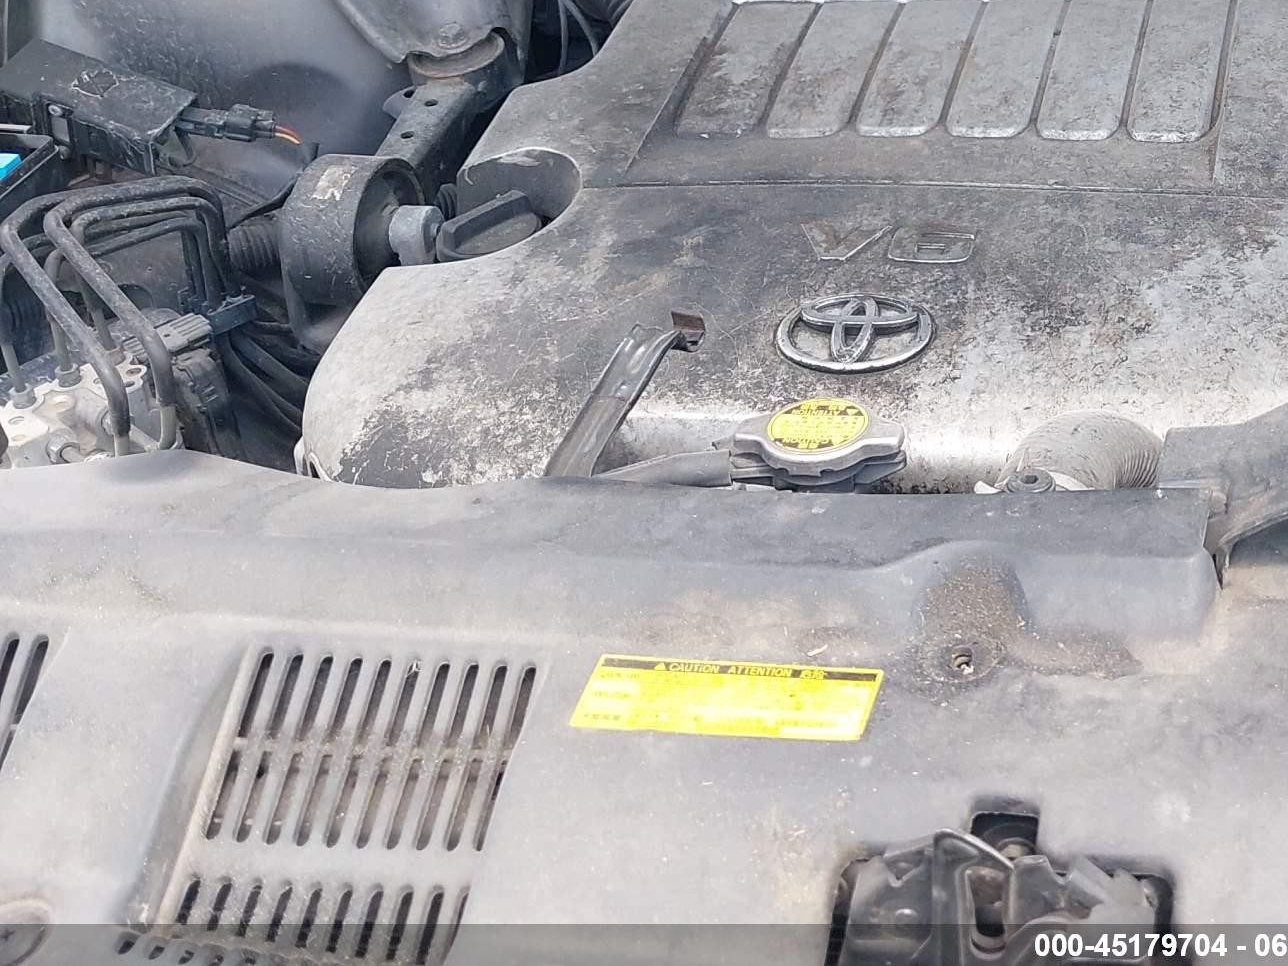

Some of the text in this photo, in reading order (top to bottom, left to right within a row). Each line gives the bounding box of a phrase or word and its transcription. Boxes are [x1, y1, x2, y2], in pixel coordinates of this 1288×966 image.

[800, 222, 980, 265] V6
[669, 662, 792, 678] CAUTION ATTENTION
